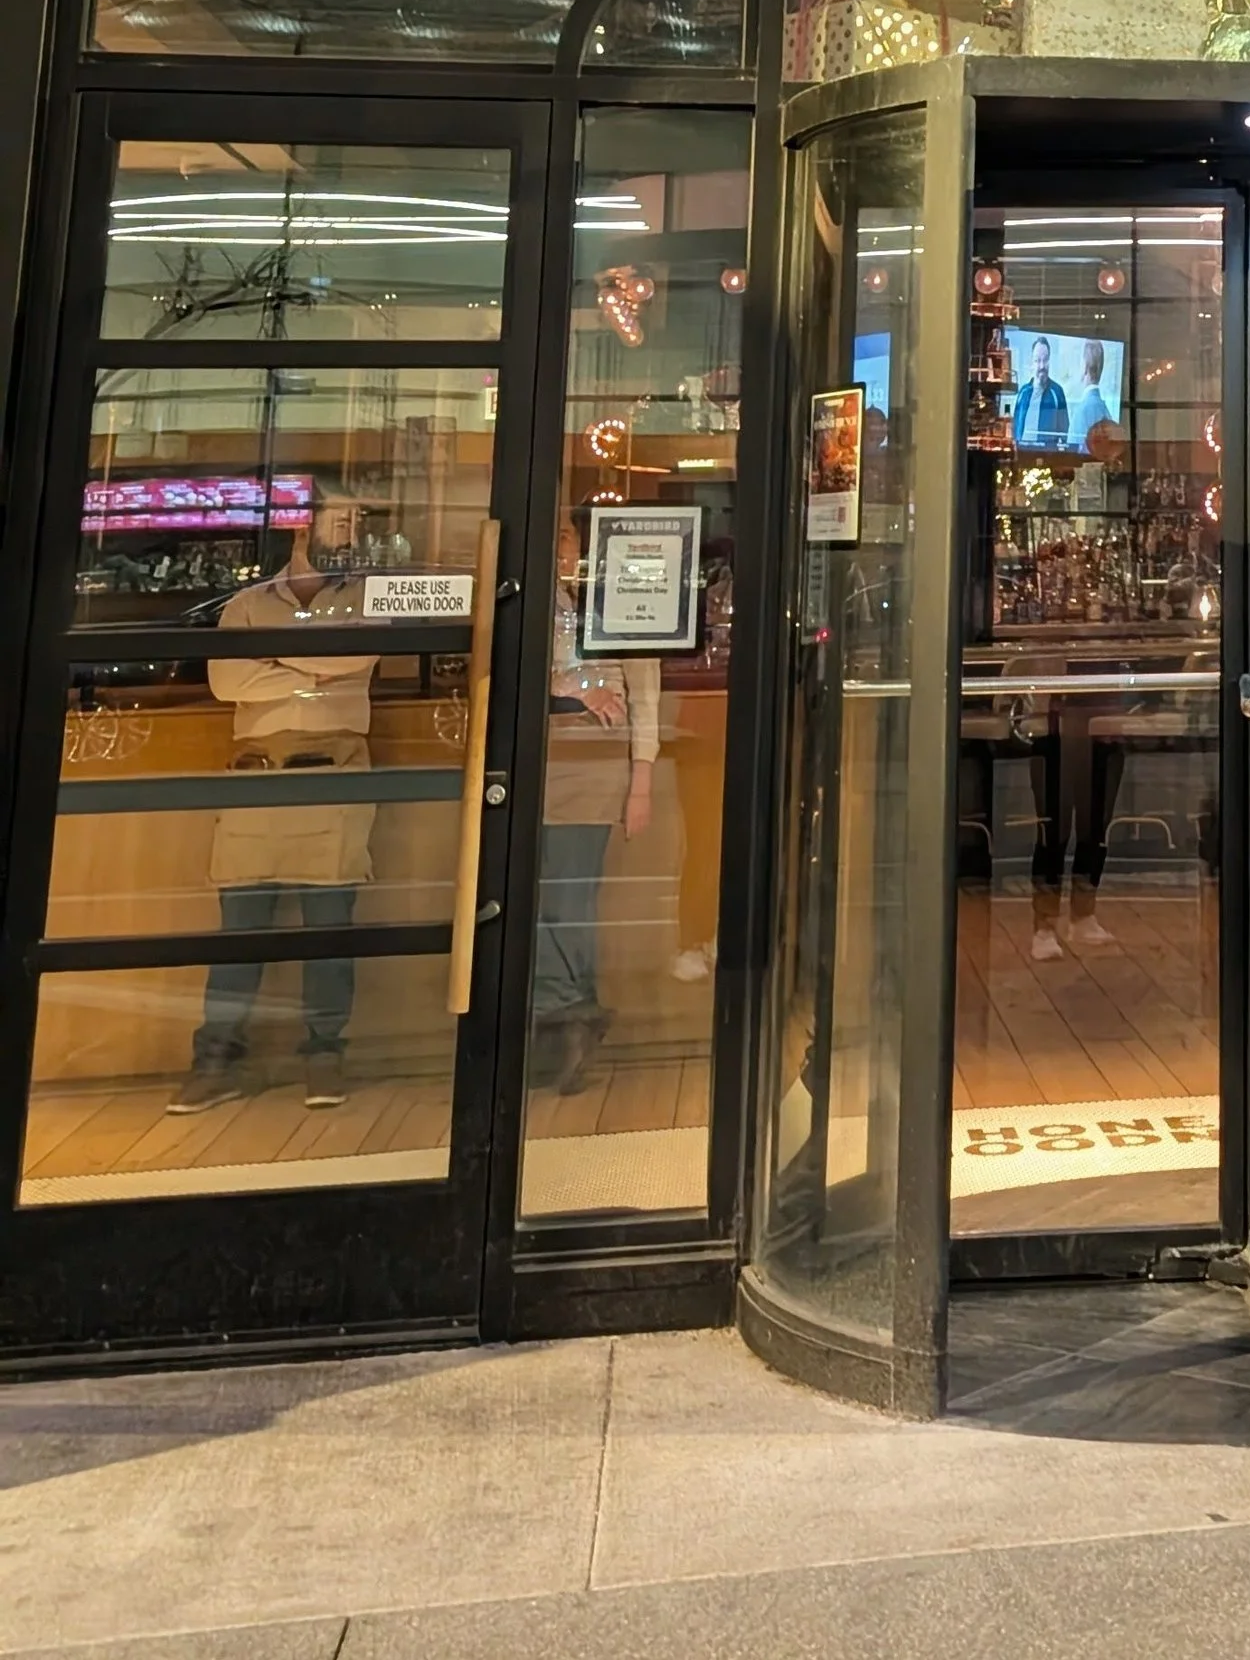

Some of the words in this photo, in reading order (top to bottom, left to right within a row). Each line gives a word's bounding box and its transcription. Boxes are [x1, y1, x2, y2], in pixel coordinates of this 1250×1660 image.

[387, 581, 429, 596] PLEASE
[430, 580, 451, 595] USE
[371, 597, 431, 612] REVOLVING
[433, 596, 464, 611] DOOR
